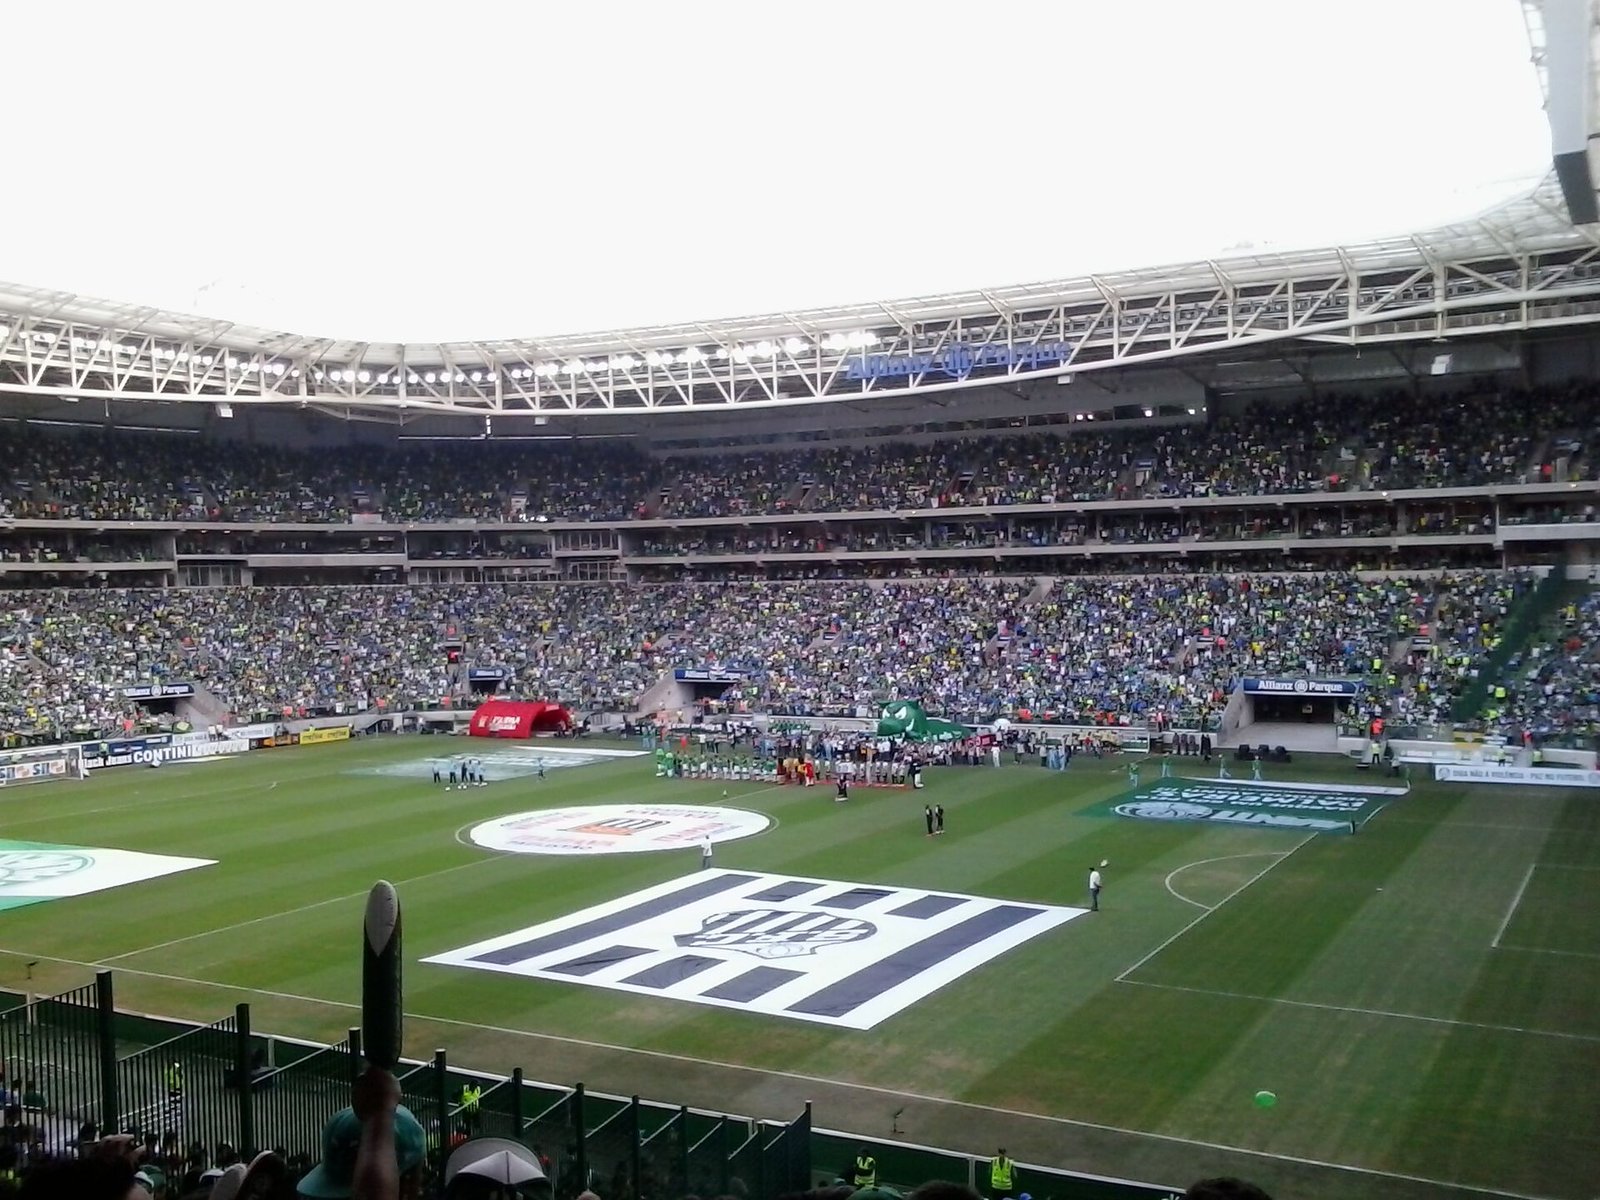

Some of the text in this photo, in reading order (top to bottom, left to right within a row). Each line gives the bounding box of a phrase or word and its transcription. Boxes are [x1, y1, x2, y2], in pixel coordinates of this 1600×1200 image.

[847, 343, 1071, 379] Allianz Parque
[1258, 681, 1343, 693] Allianz Parque
